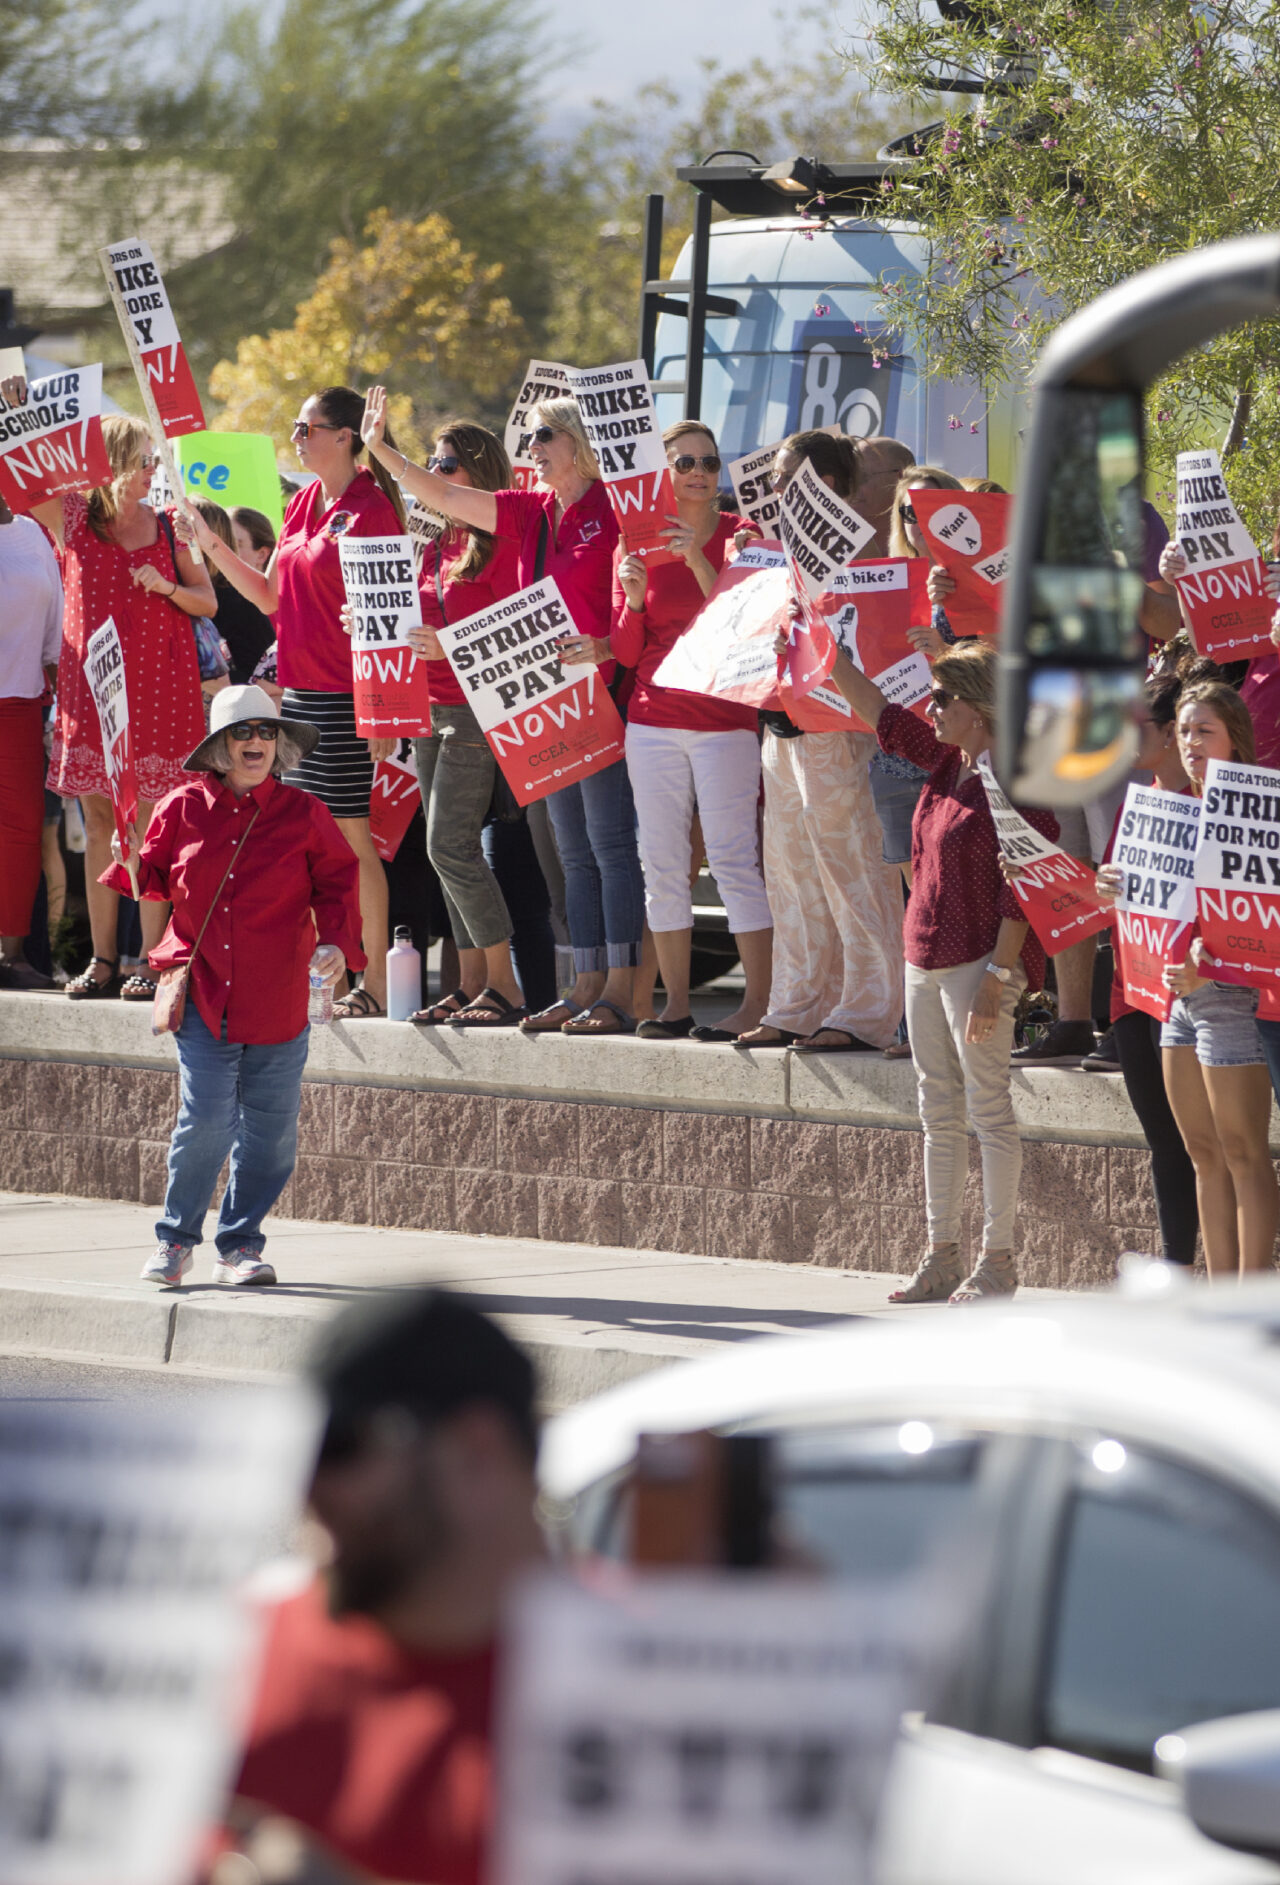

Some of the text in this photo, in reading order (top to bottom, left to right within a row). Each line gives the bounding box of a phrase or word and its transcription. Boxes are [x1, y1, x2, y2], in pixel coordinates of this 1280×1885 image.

[124, 292, 164, 316] ORE
[616, 369, 634, 381] ON
[575, 384, 650, 418] TRIKE
[3, 417, 90, 490] NOW!
[801, 469, 861, 534] EDUCATORS ON
[785, 480, 856, 566] STRIKE
[939, 512, 968, 539] Want
[1191, 507, 1236, 530] MORE
[386, 543, 402, 554] ON
[965, 536, 978, 549] A
[1181, 532, 1235, 564] PAY
[343, 559, 413, 585] STRIKE
[790, 538, 832, 583] MORE
[853, 570, 894, 585] bike?
[1179, 557, 1263, 609] NOW!
[364, 590, 413, 609] MORE
[356, 614, 399, 641] PAY
[453, 588, 546, 640] EDUCATORS ON
[1211, 611, 1243, 629] CCEA
[451, 599, 568, 671] STRIKE
[352, 650, 418, 684] NOW!
[466, 660, 513, 692] FOR
[886, 674, 900, 686] Dr.
[899, 663, 918, 678] Jara
[495, 659, 566, 710] PAY
[489, 673, 595, 758] NOW!
[528, 741, 570, 767] CCEA
[1135, 793, 1190, 816] EDUCATORS
[1204, 822, 1244, 845] FOR
[1000, 836, 1044, 860] PAY
[1118, 844, 1148, 868] FOR
[1012, 852, 1087, 902] NOW!
[1127, 873, 1178, 910] PAY
[1118, 911, 1187, 960] NOW!
[1226, 935, 1267, 953] CCEA
